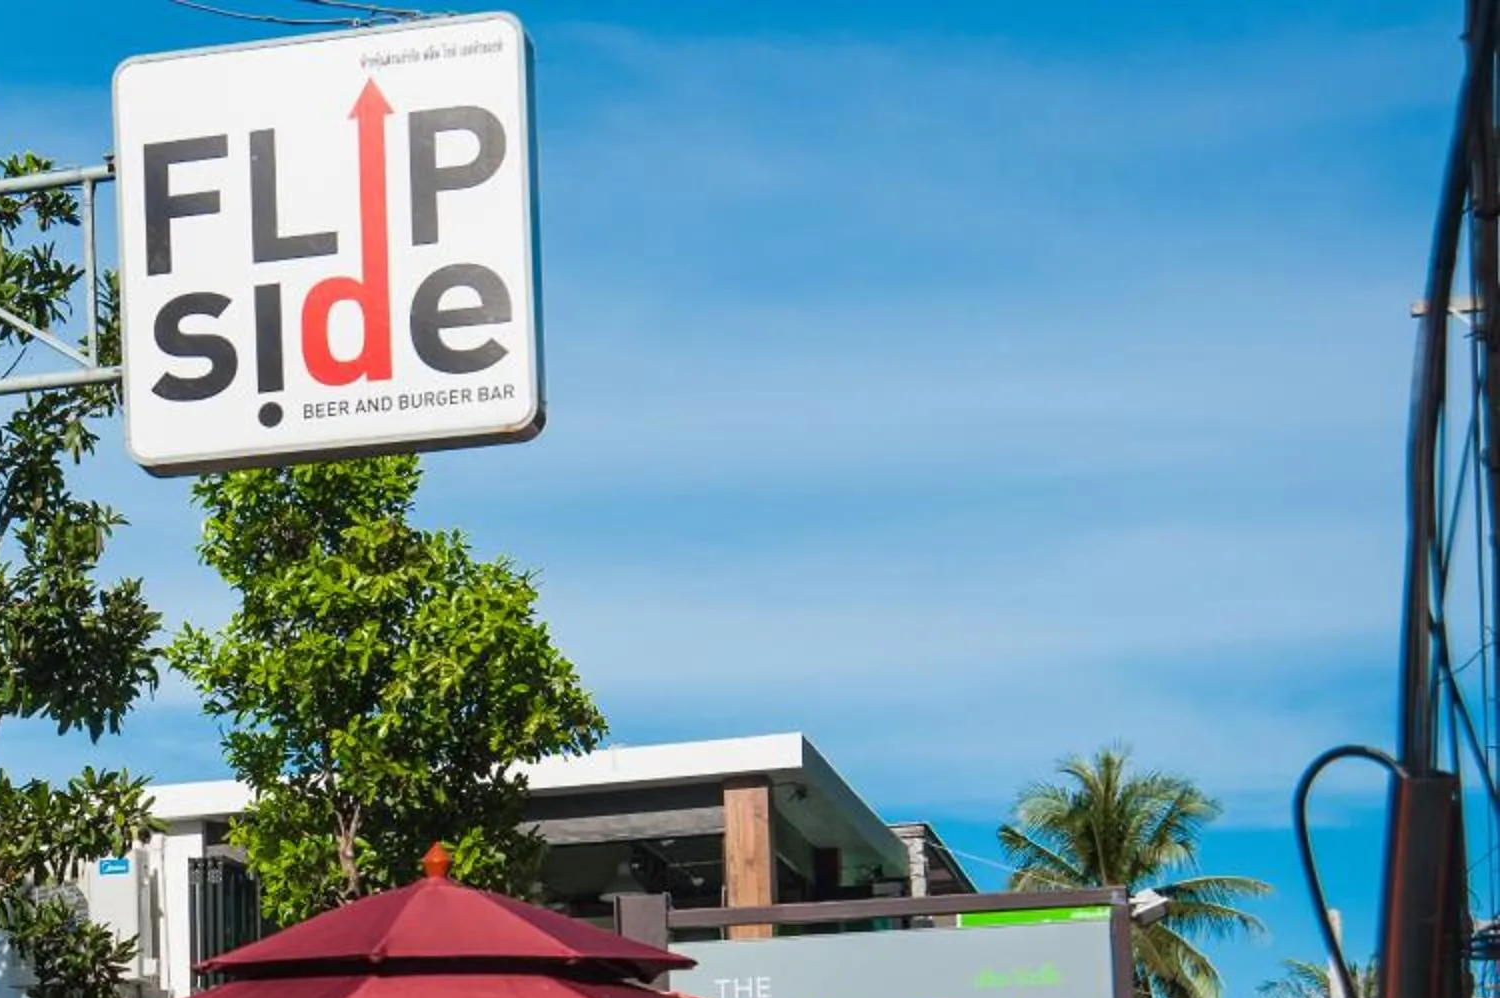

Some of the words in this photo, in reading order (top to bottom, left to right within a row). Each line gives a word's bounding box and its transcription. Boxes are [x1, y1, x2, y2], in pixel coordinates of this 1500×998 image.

[303, 402, 349, 419] BEER
[355, 396, 393, 413] AND
[400, 389, 472, 410] BURGER
[478, 384, 515, 401] BAR
